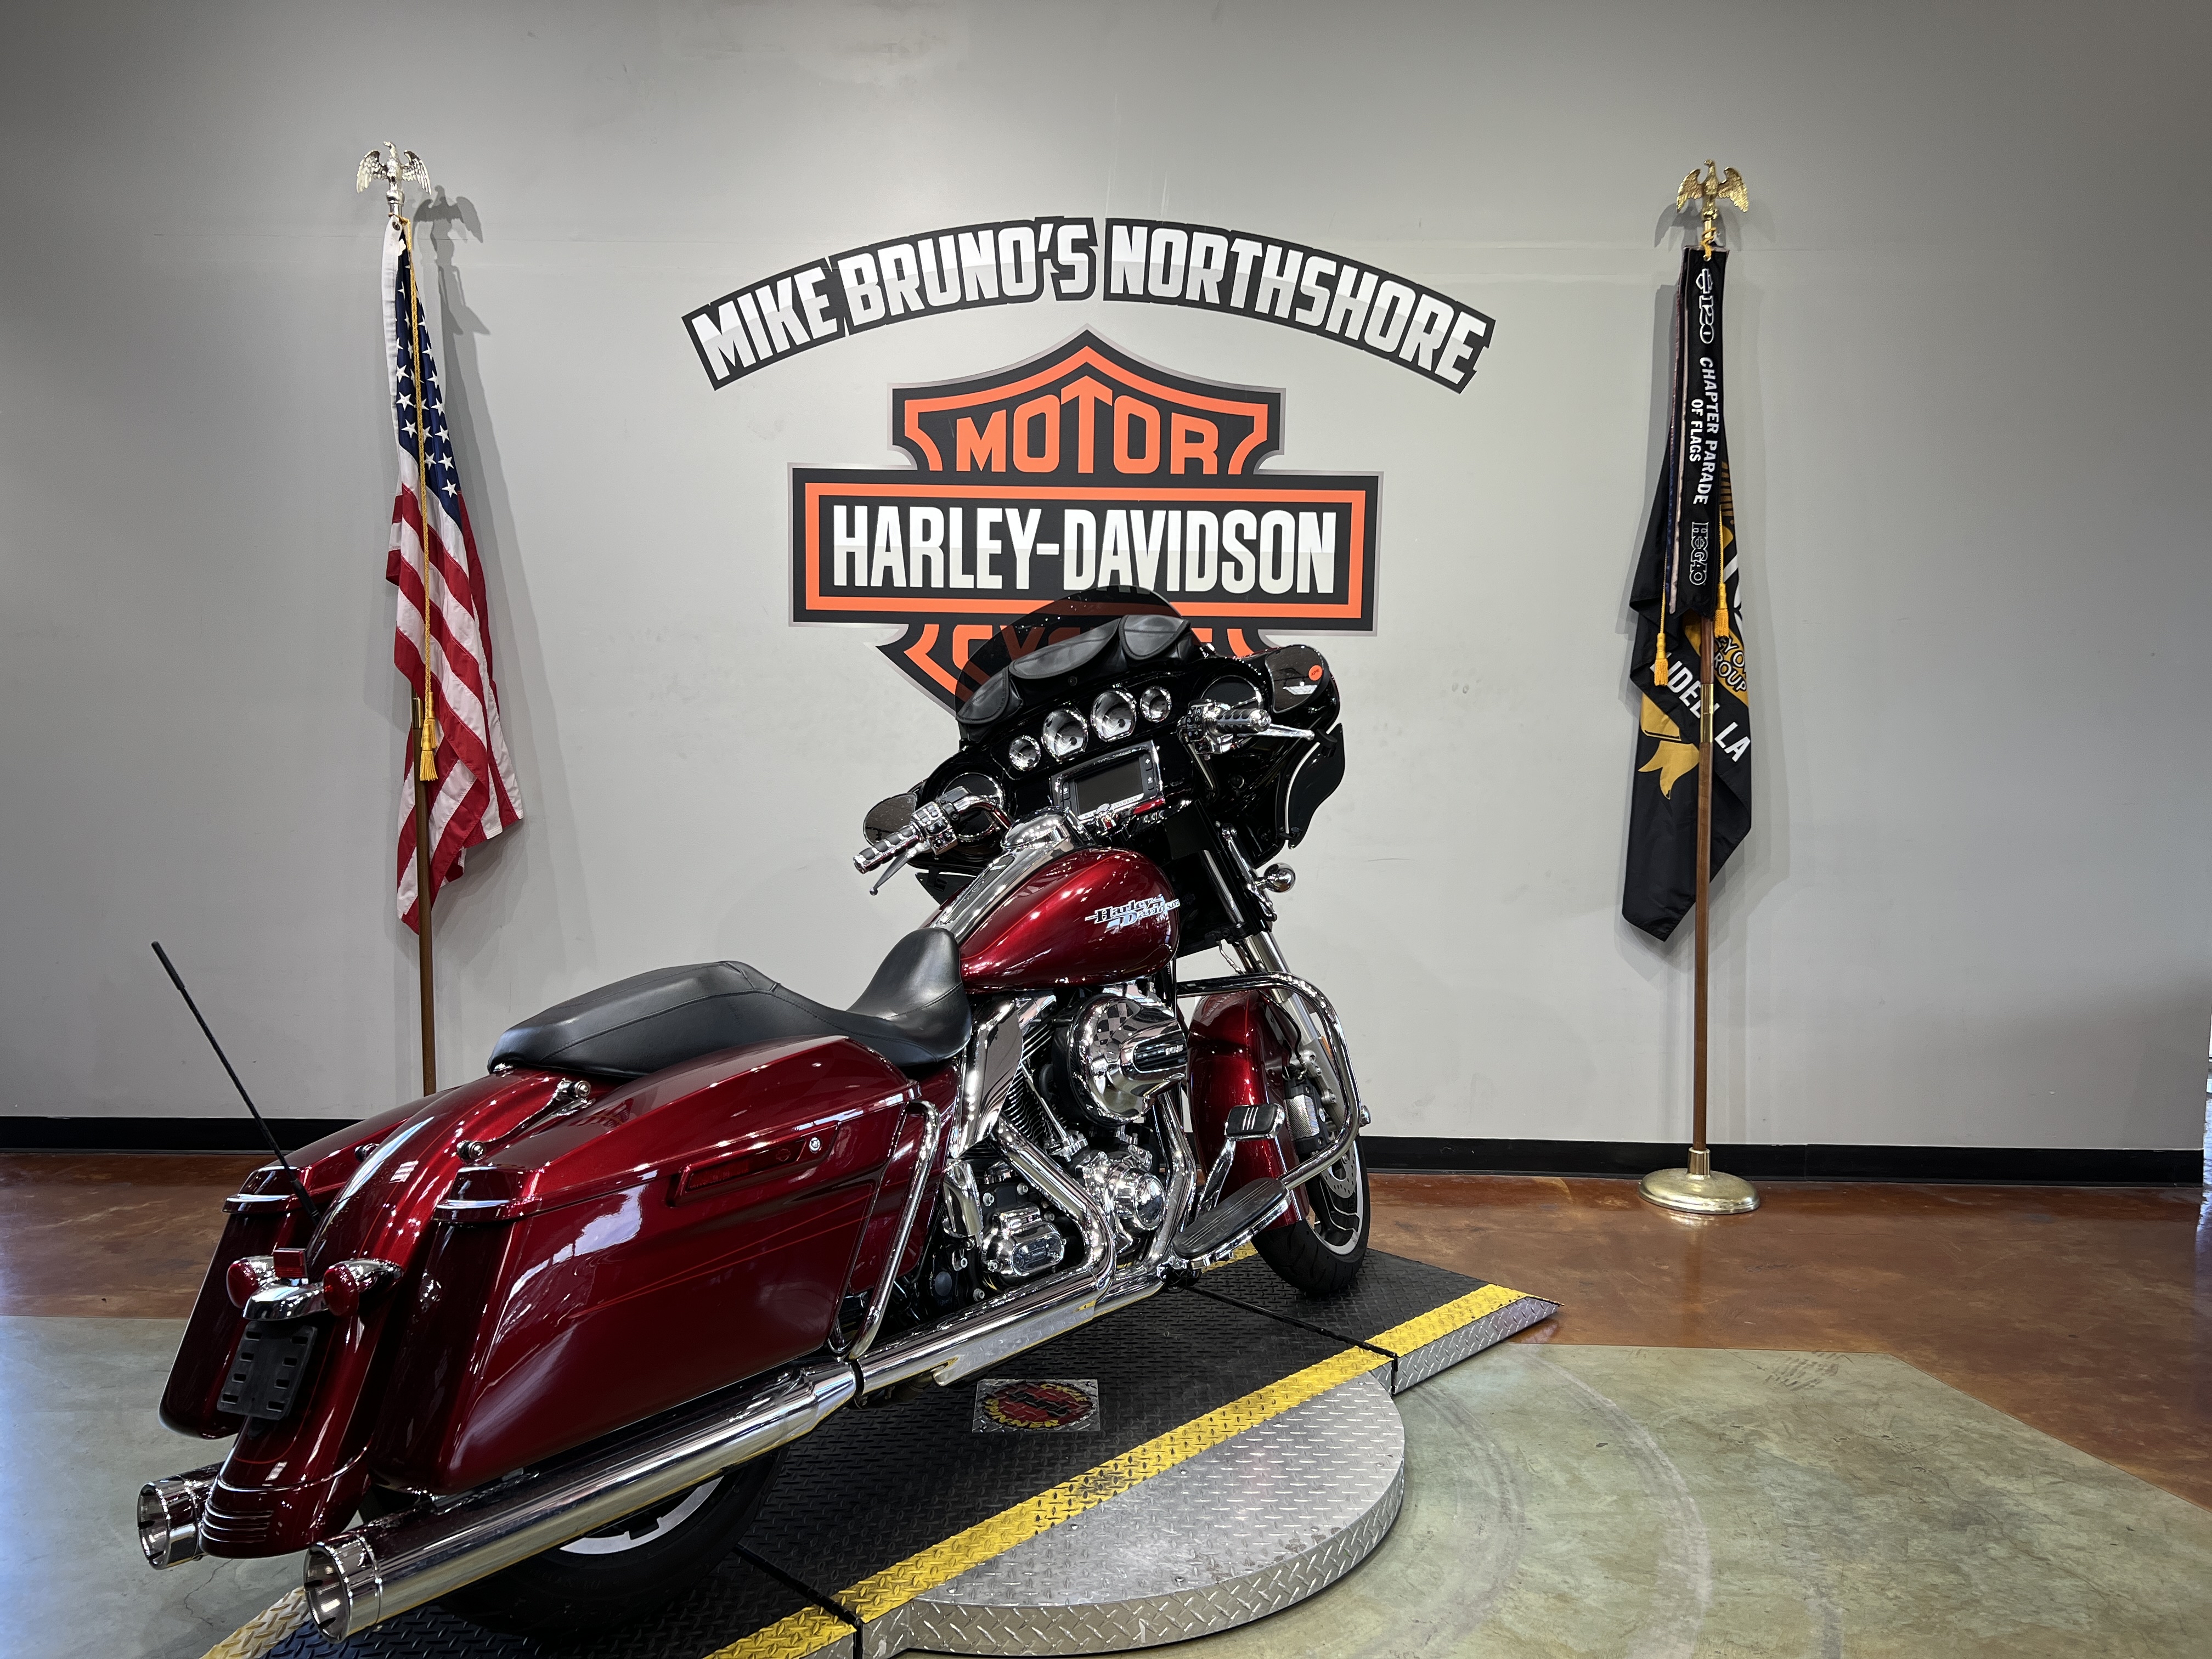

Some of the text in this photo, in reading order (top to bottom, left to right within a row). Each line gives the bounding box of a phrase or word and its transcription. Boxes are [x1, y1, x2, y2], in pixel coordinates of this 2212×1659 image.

[691, 223, 1487, 385] MIKE BRUNO'S NORTHSHORE
[956, 375, 1218, 475] MOTOR
[1689, 398, 1703, 462] OF FLAGS
[1693, 357, 1720, 505] CHAPTER PARADE
[833, 505, 1337, 594] HARLEY-DAVIDSON
[1713, 651, 1747, 691] ROUP
[1714, 721, 1751, 763] LA
